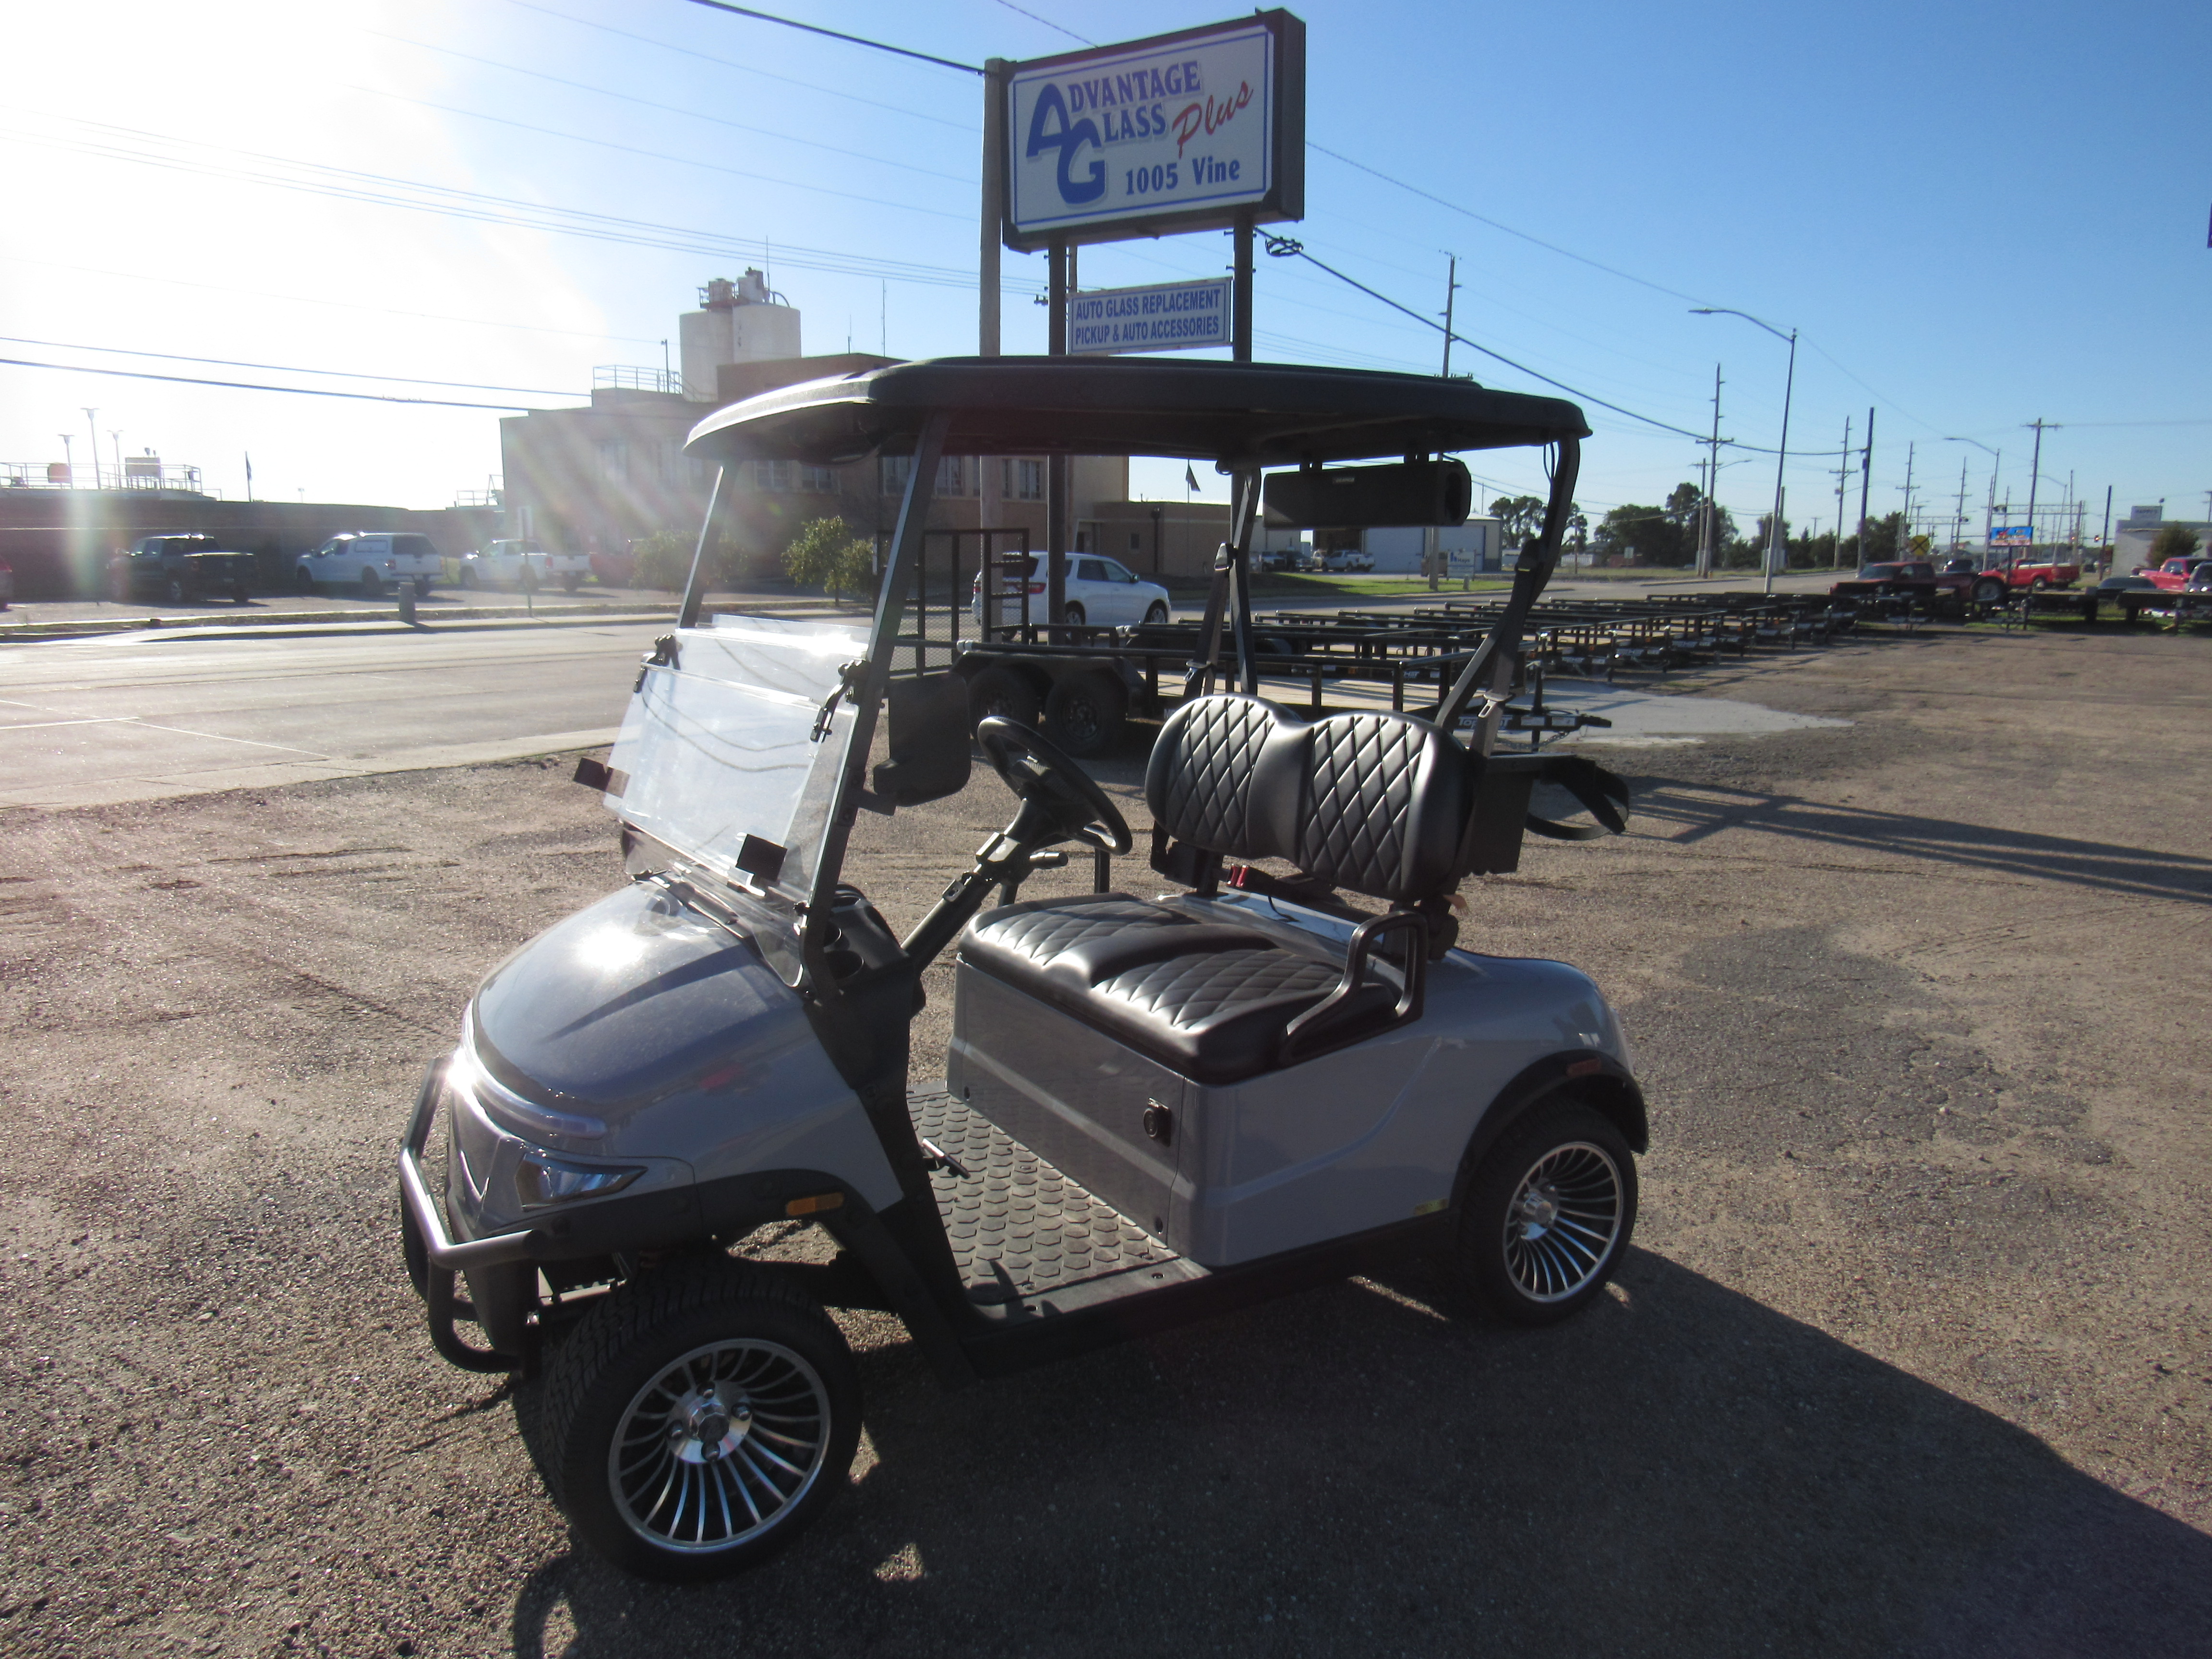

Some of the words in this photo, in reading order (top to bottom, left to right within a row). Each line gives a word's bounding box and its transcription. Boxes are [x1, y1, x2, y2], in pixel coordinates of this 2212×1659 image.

[1171, 80, 1254, 159] Plus
[1126, 163, 1178, 195] 1005
[1192, 156, 1240, 185] Vine
[1076, 301, 1103, 320] AUTO
[1106, 296, 1139, 318] GLASS
[1142, 289, 1221, 315] REPLACEMENT
[1076, 325, 1109, 345] PICKUP
[1113, 325, 1119, 342] &
[1122, 322, 1148, 341] AUTO
[1151, 315, 1219, 339] ACCESSORIES
